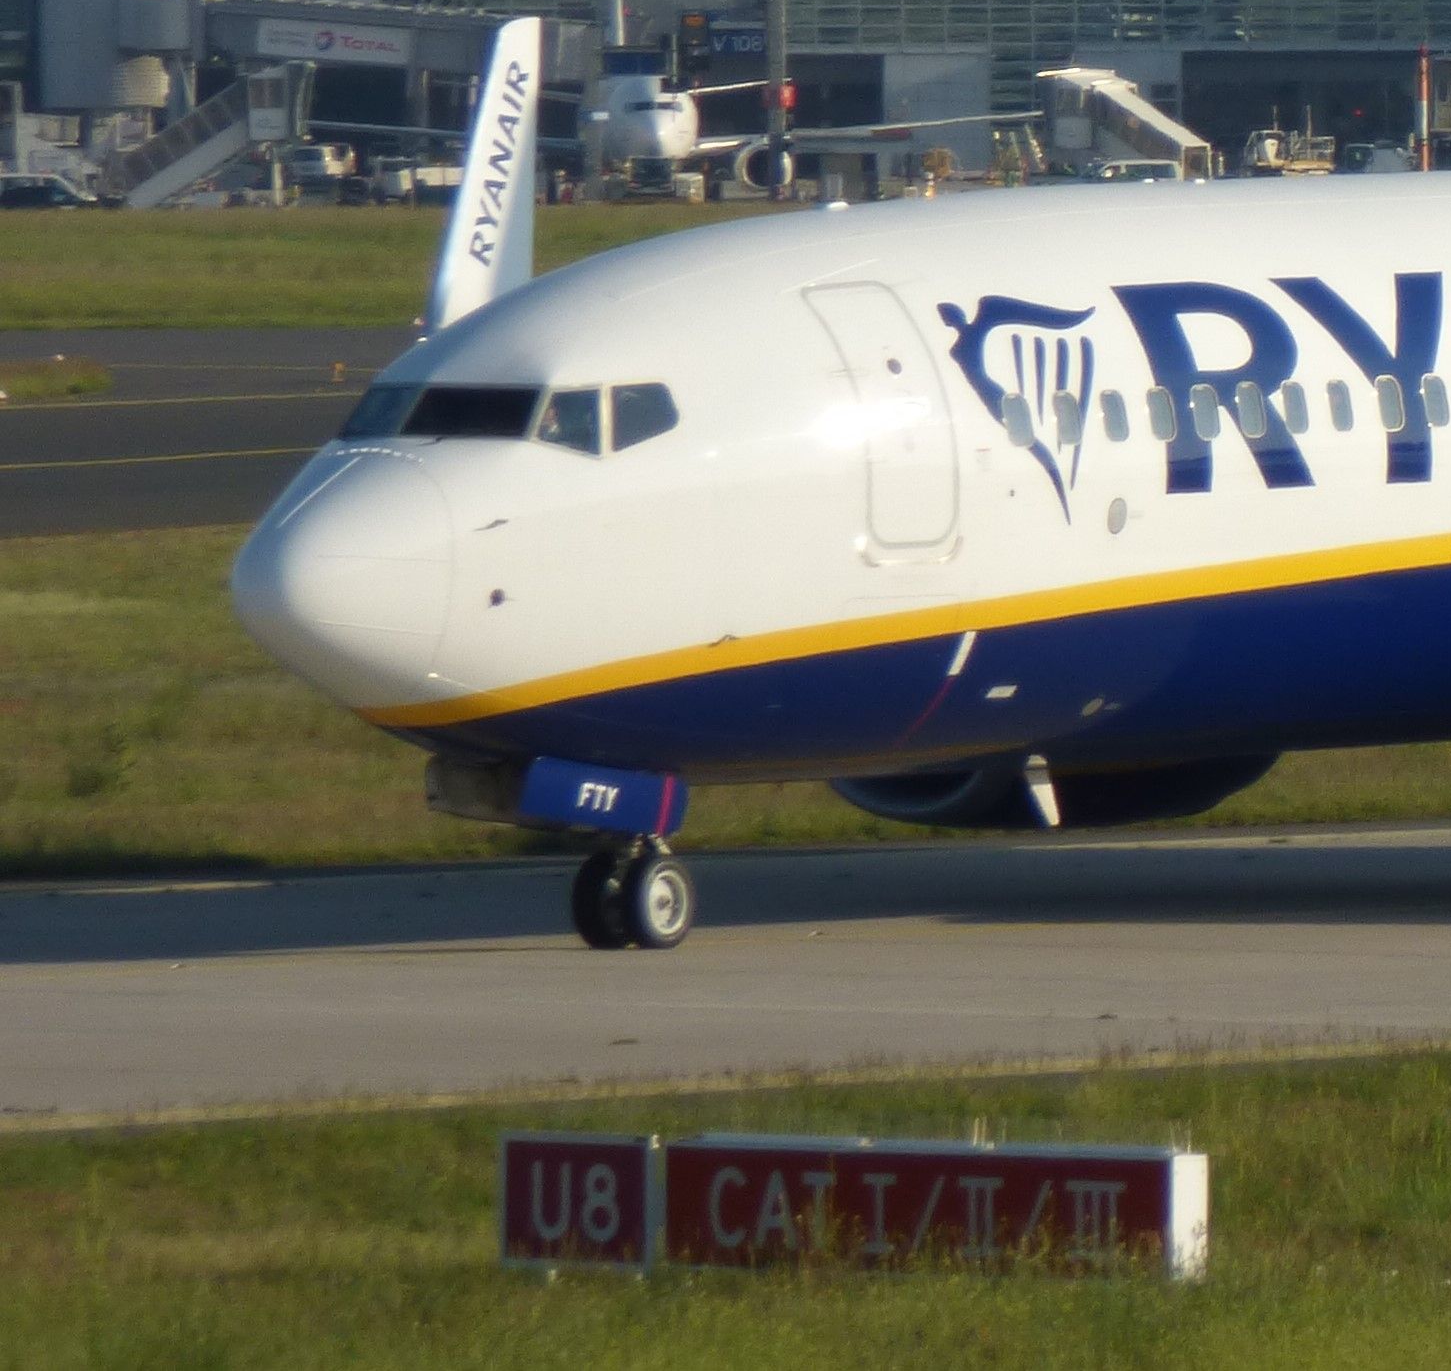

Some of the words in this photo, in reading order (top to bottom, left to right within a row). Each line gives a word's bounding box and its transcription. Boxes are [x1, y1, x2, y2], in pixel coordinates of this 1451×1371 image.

[713, 34, 727, 51] V
[470, 60, 529, 267] RYANAIR
[576, 782, 619, 812] FTY
[532, 1159, 621, 1244] U8
[708, 1165, 838, 1257] CAT
